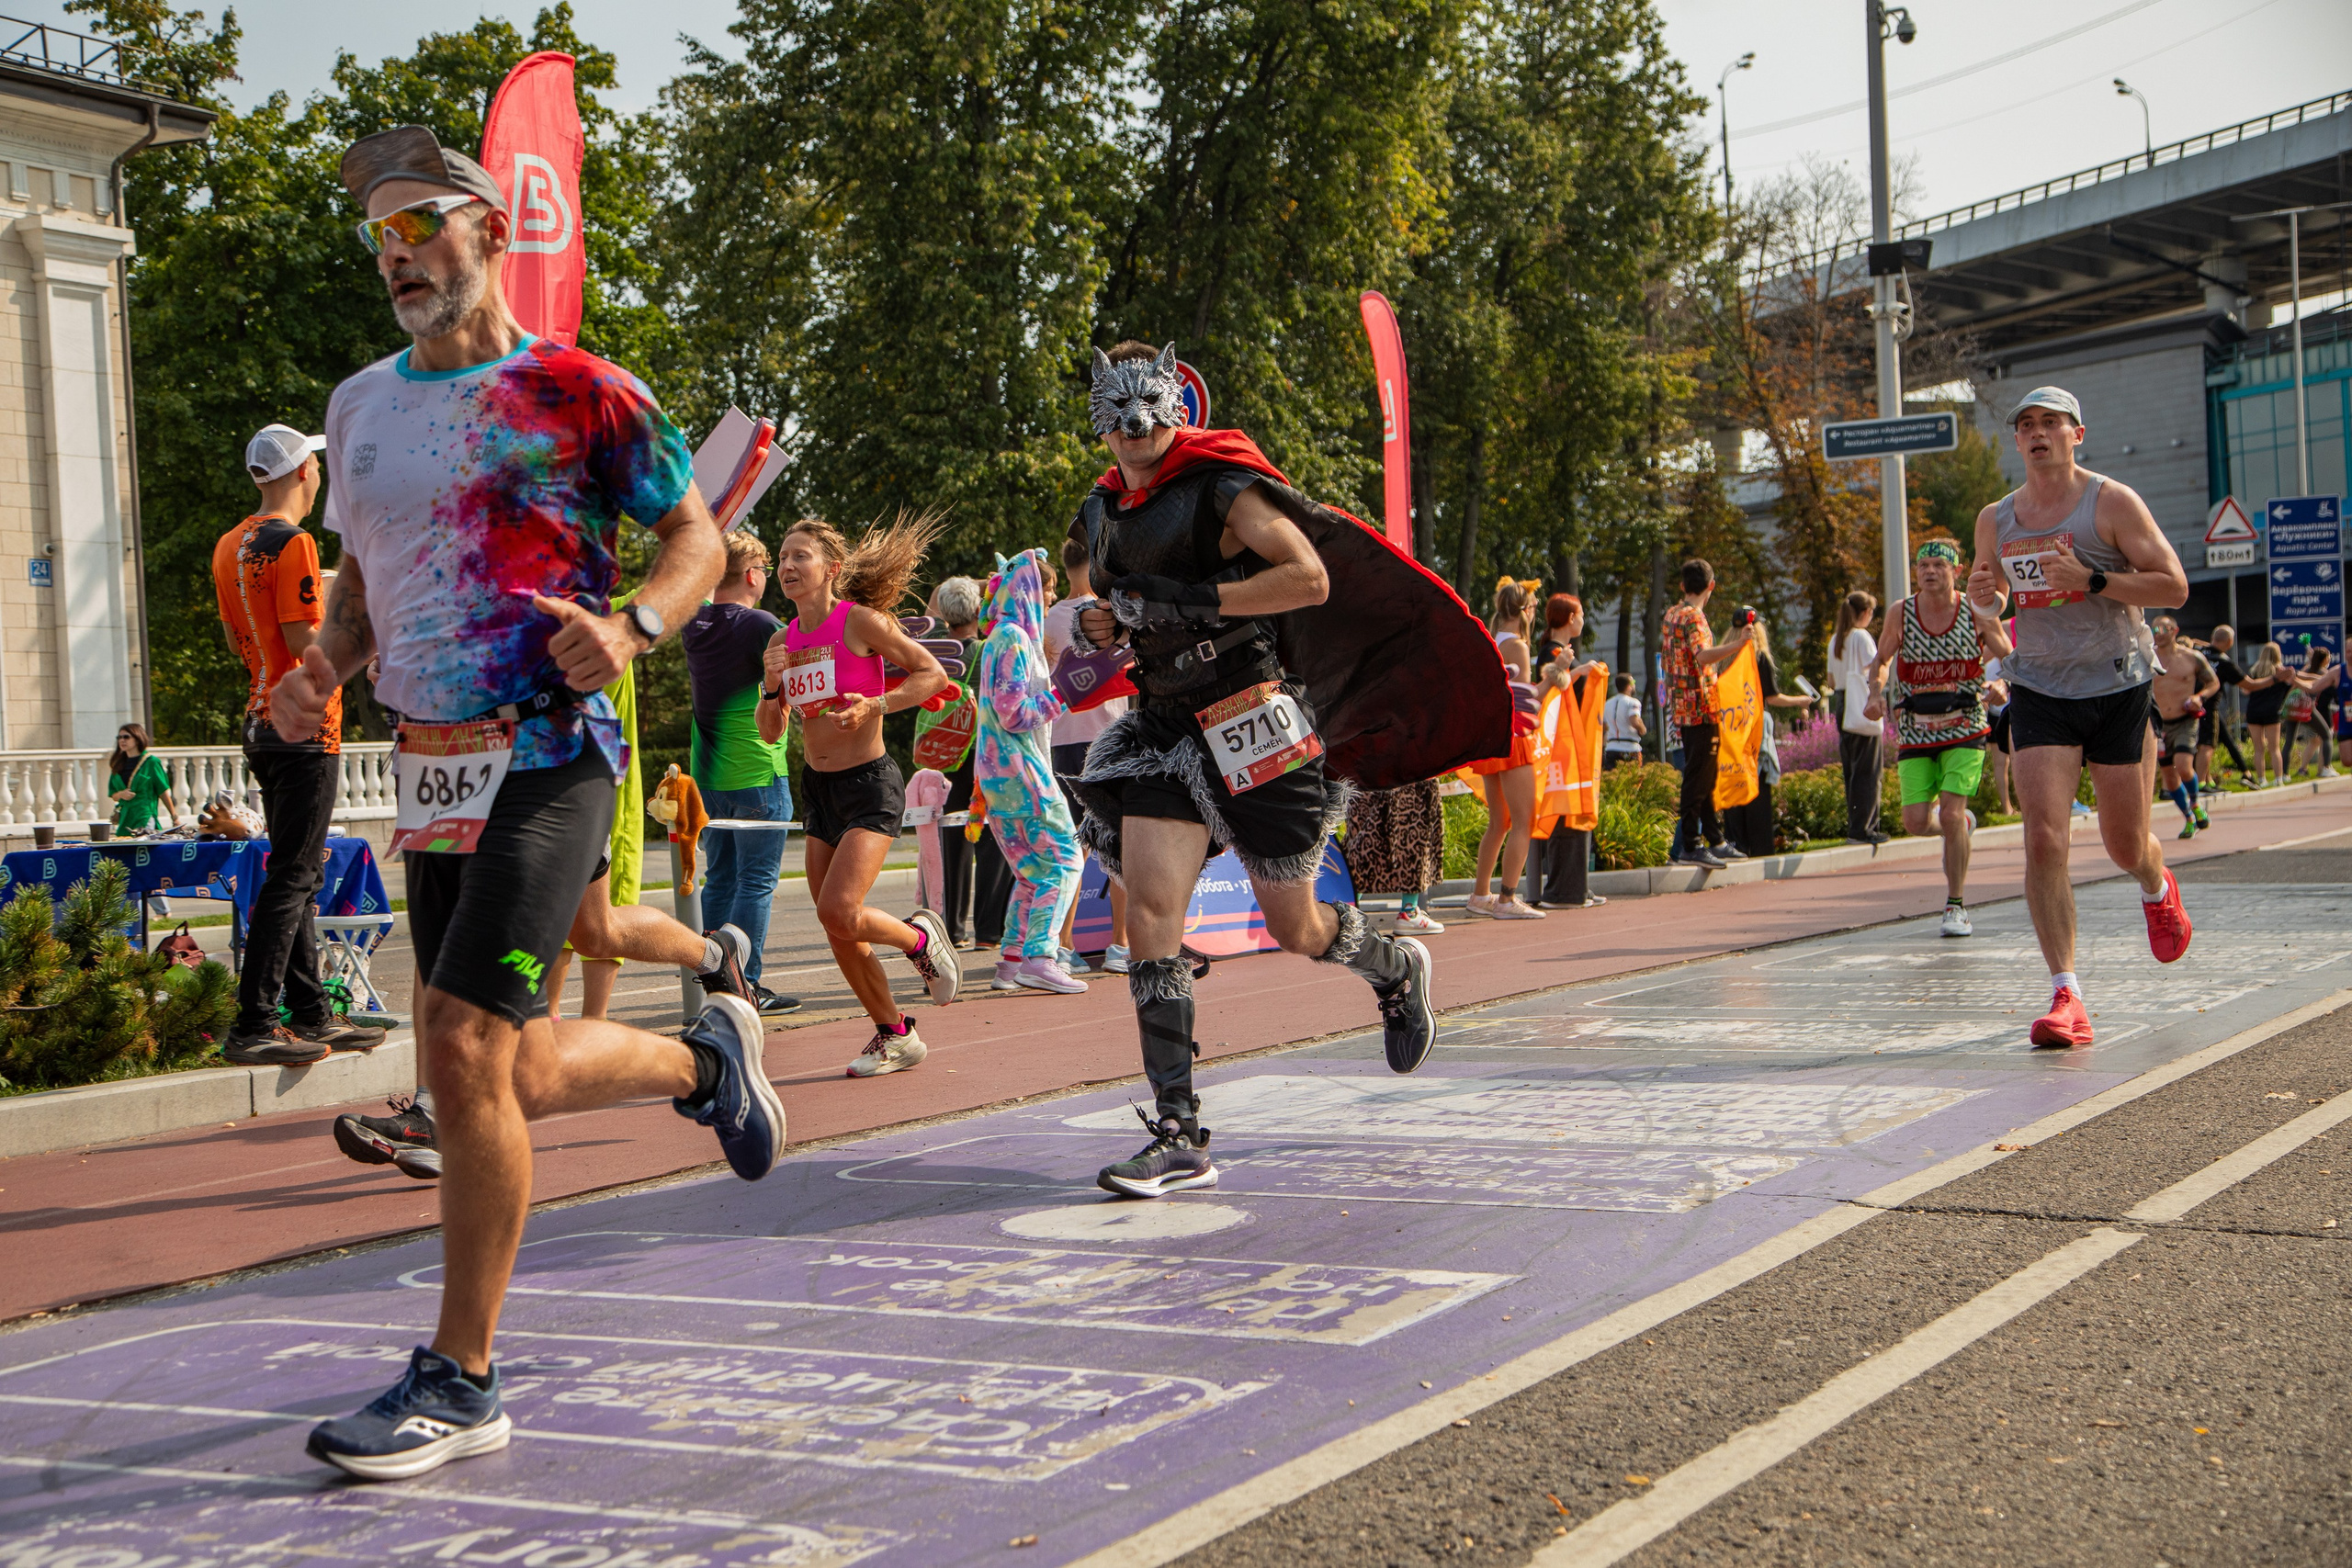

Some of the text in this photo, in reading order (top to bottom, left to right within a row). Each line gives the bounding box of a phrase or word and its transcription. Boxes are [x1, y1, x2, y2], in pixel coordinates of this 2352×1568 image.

[1843, 436, 1883, 448] Restaurant
[2270, 521, 2338, 535] Аквакомплекс
[2273, 530, 2335, 543] «Лужники»
[2274, 541, 2336, 554] Aquatic Center
[33, 562, 48, 577] 24
[2012, 559, 2045, 581] 52
[2271, 581, 2341, 598] Верёвочный
[2018, 593, 2027, 605] B
[2291, 594, 2320, 606] парк
[2284, 604, 2328, 616] Rope park
[820, 646, 831, 655] 21,1
[1913, 662, 1967, 680] ЛУЖНИКИ
[788, 671, 826, 698] 8613
[1221, 704, 1291, 753] 5710
[486, 738, 508, 752] KM
[1251, 737, 1283, 756] СЕМЁН
[1237, 772, 1250, 787] A
[1193, 878, 1234, 897] уббота
